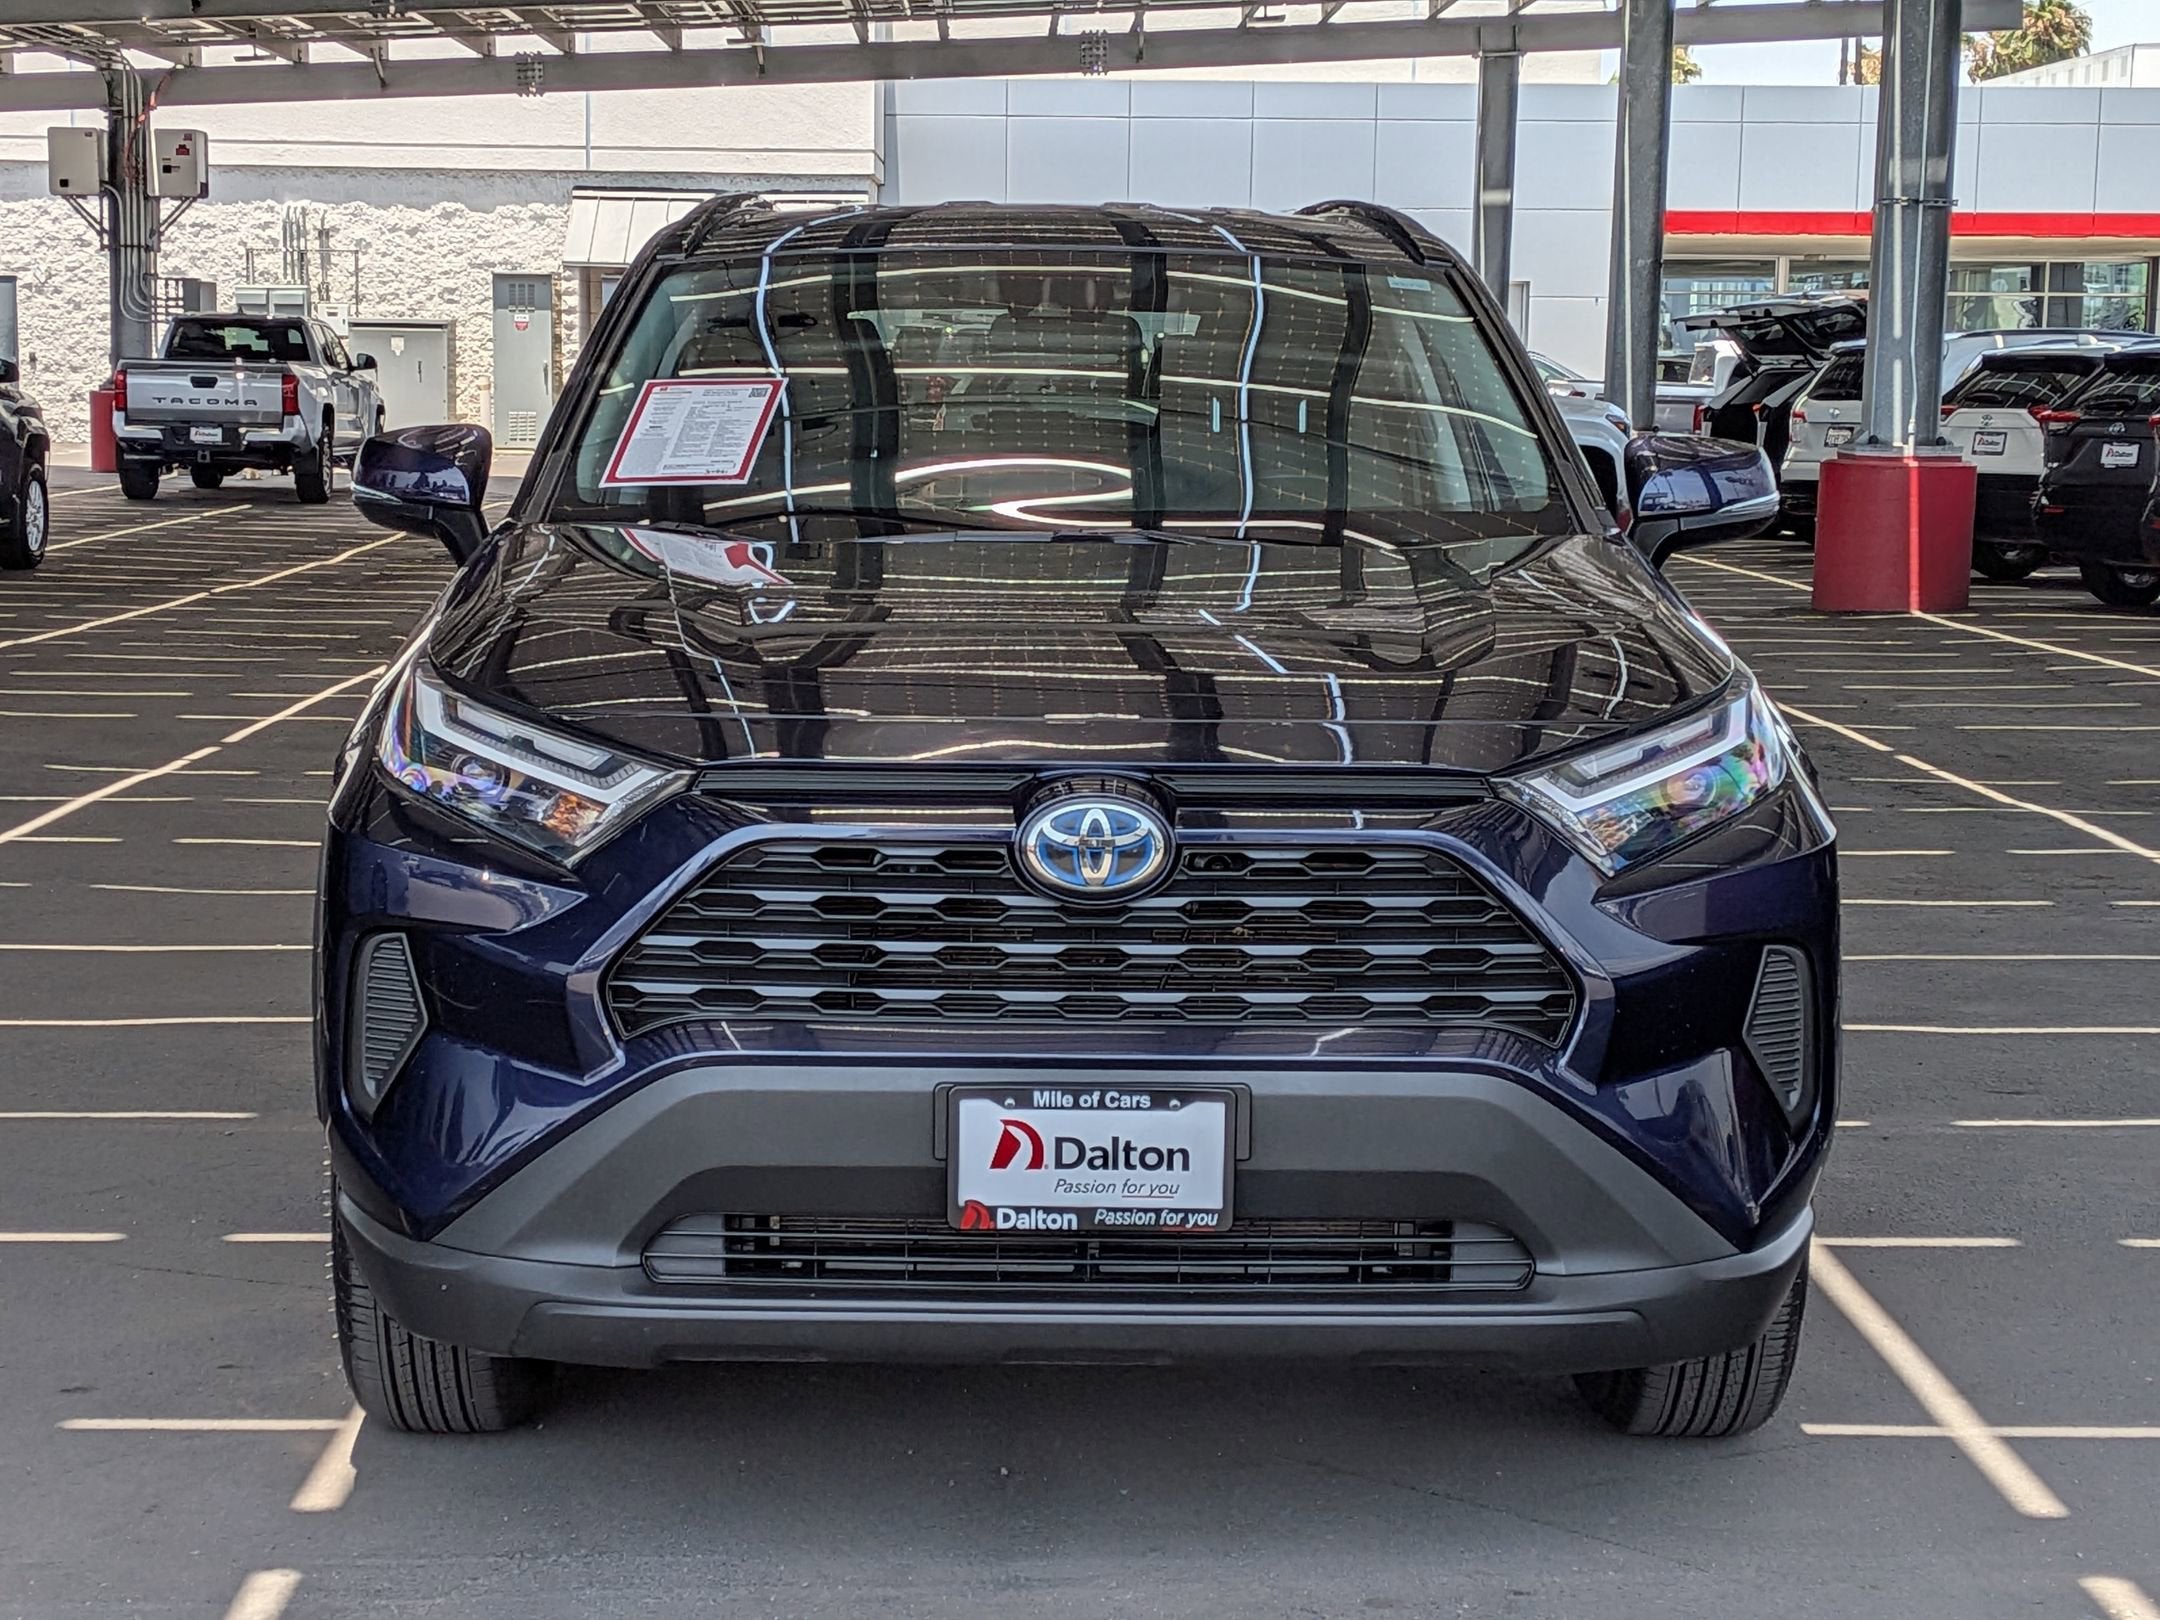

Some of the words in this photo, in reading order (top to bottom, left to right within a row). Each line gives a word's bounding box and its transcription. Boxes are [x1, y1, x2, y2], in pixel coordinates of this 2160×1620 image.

[152, 397, 258, 406] TACOMA
[1033, 1090, 1073, 1108] Mile
[1079, 1091, 1099, 1108] of
[1105, 1091, 1151, 1109] Cars
[1054, 1136, 1190, 1172] Dalton
[1054, 1178, 1116, 1194] Passion
[1122, 1179, 1144, 1194] for
[1149, 1183, 1179, 1197] you
[997, 1208, 1078, 1230] Dalton
[1095, 1209, 1155, 1226] Passion
[1160, 1210, 1183, 1226] for
[1186, 1212, 1218, 1229] you
